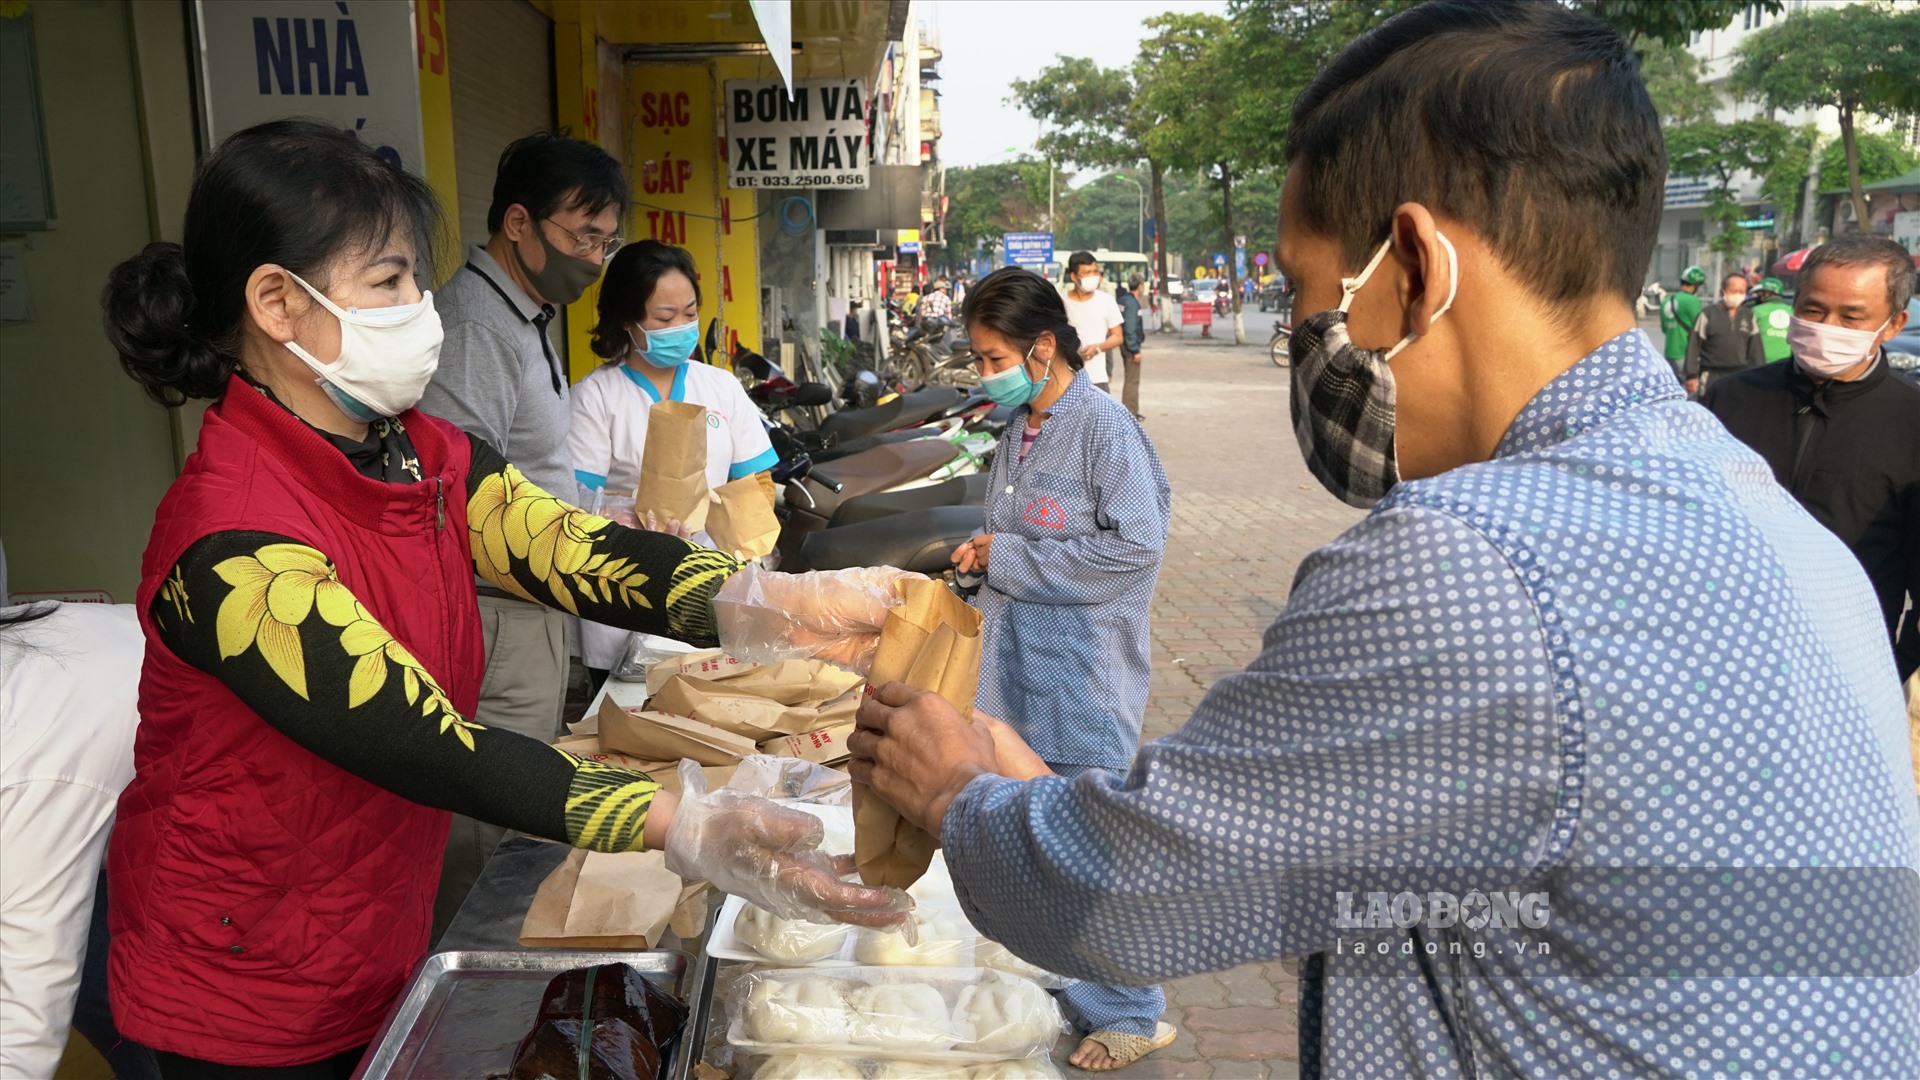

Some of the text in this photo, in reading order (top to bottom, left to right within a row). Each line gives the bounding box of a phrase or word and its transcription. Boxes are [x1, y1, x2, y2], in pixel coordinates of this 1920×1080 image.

[253, 2, 369, 95] NHÀ
[641, 92, 690, 134] SẠC
[734, 79, 863, 122] BƠM VÁ
[736, 137, 777, 171] XE
[790, 128, 863, 170] MÁY
[643, 152, 692, 194] CÁP
[763, 174, 864, 187] 033.2500.956
